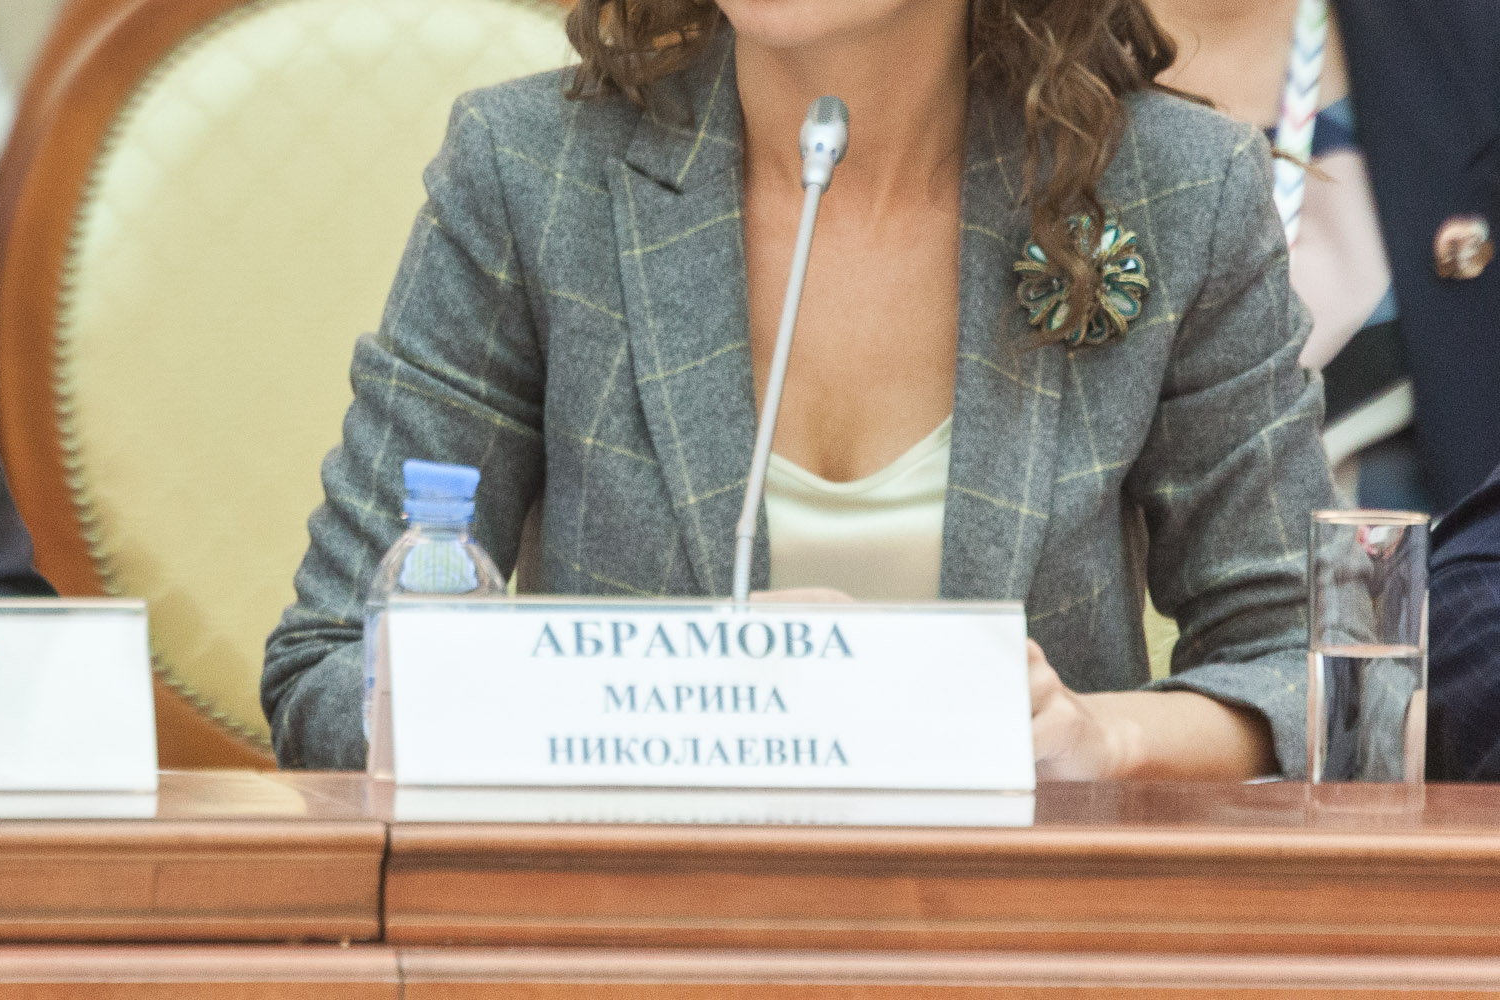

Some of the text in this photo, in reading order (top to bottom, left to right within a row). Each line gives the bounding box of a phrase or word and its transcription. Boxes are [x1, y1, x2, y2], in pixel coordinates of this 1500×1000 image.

[531, 620, 854, 659] АБРАМОВА
[603, 684, 789, 714] МАРИНА
[547, 736, 850, 767] НИКОЛАЕВНА
